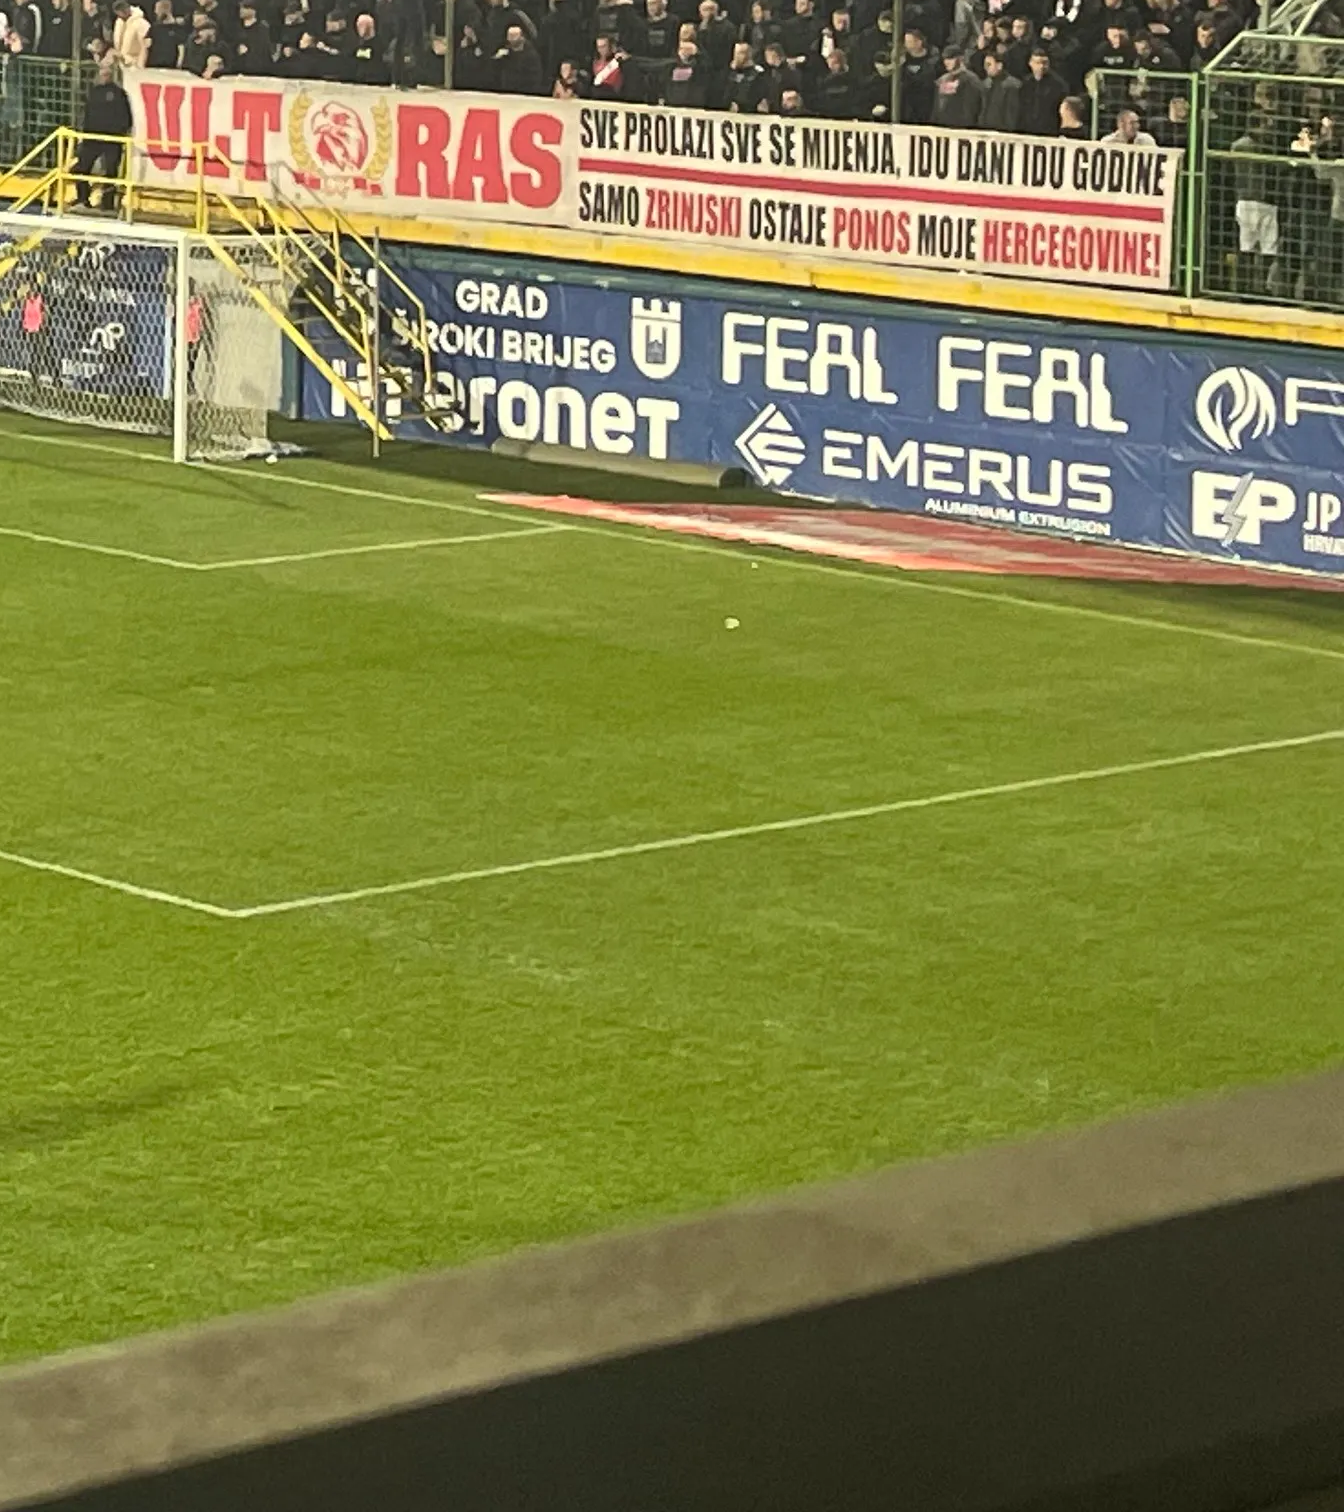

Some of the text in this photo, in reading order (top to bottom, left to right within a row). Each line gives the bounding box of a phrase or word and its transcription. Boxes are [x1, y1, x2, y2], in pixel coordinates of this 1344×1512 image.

[139, 82, 564, 209] ULT RAS
[579, 107, 1167, 196] SVE PROLAZI SVE SE MIJENJA, IDU DANI IDU GODINE
[578, 180, 1161, 278] SAMO ZRINJSKI OSTAJE PONOS MOJE HERCEGOVINE!
[455, 279, 549, 320] GRAD
[502, 333, 616, 373] BRIJEG
[721, 311, 899, 405] FEAL
[937, 336, 1129, 434] FEAL
[822, 428, 1113, 515] EMERUS
[1191, 470, 1341, 546] EP JP
[924, 498, 1111, 536] ALUMINIUM EXTRUSION
